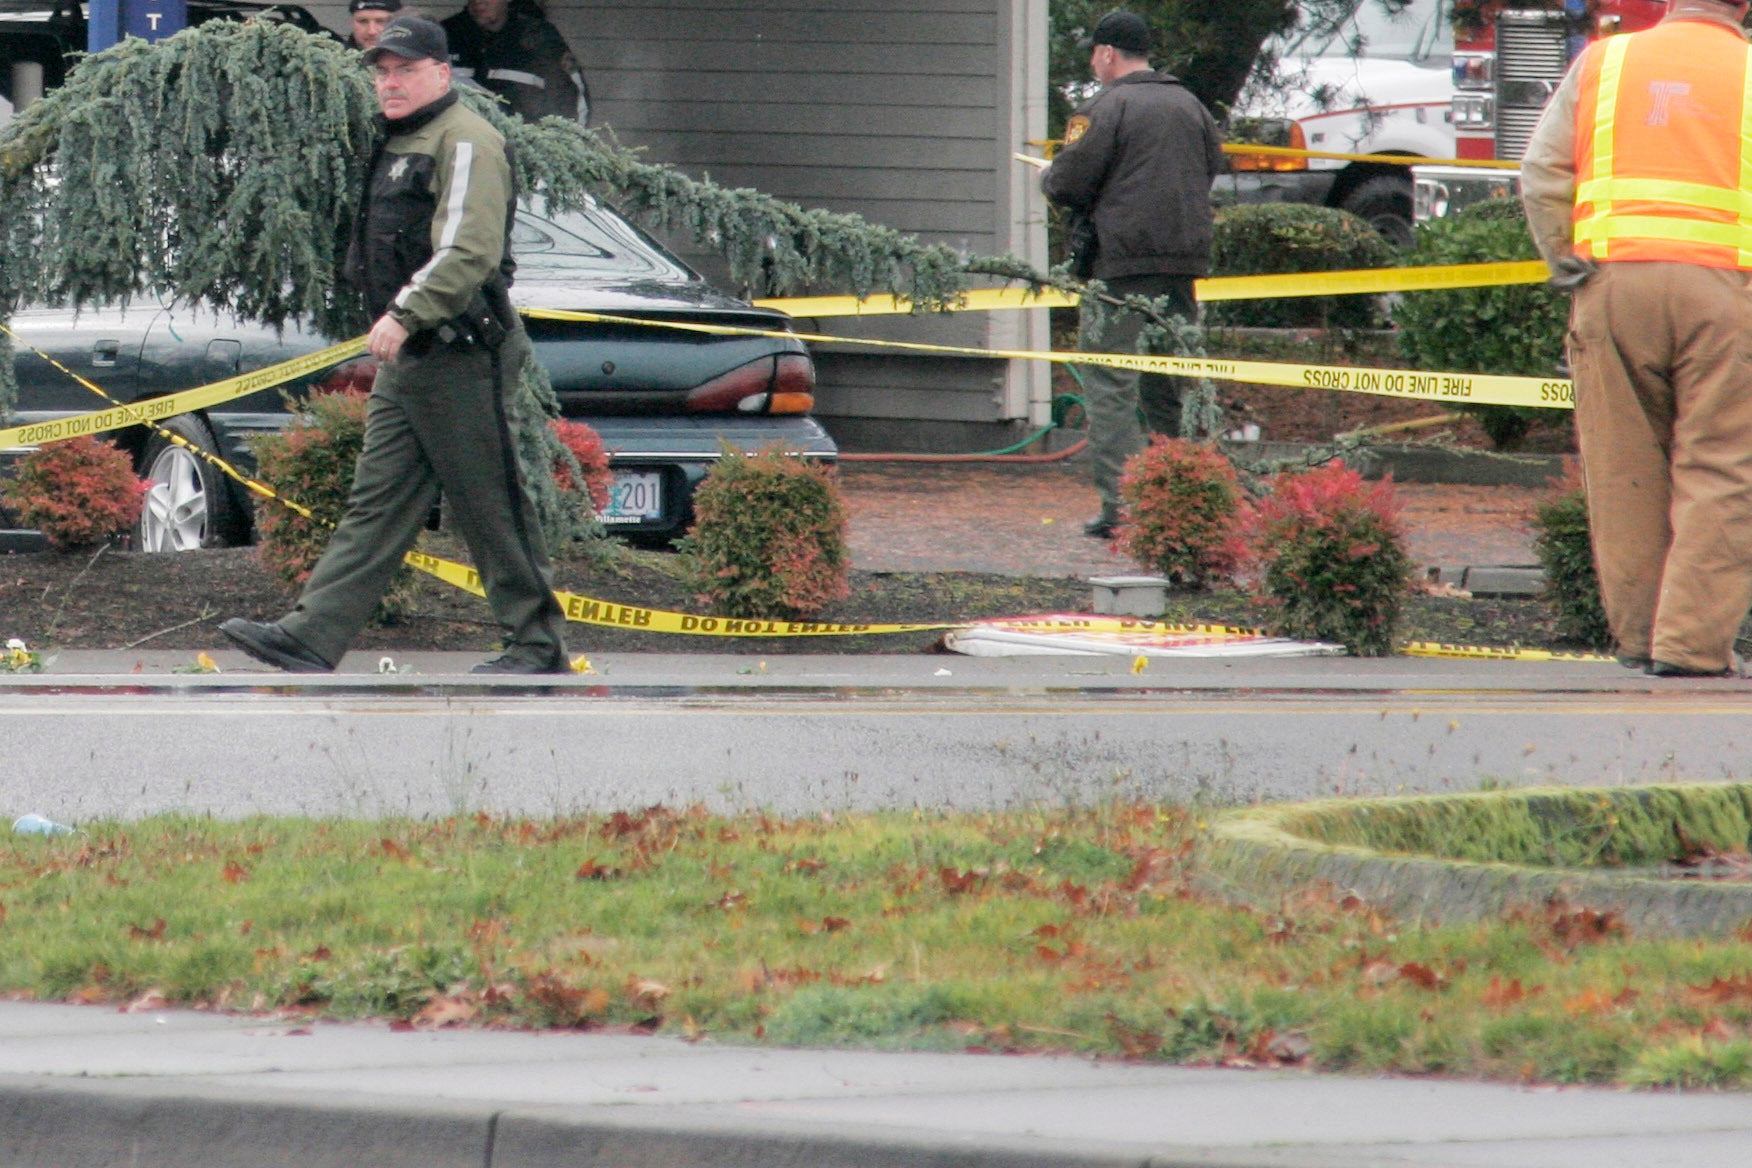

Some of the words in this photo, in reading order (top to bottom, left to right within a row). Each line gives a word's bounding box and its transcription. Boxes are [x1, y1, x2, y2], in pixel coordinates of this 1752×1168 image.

[1303, 368, 1350, 390] CROSS
[1353, 372, 1381, 392] NOT
[1384, 373, 1404, 393] DO
[1408, 375, 1439, 396] LINE
[1442, 377, 1473, 397] FIRE
[621, 482, 658, 511] 201
